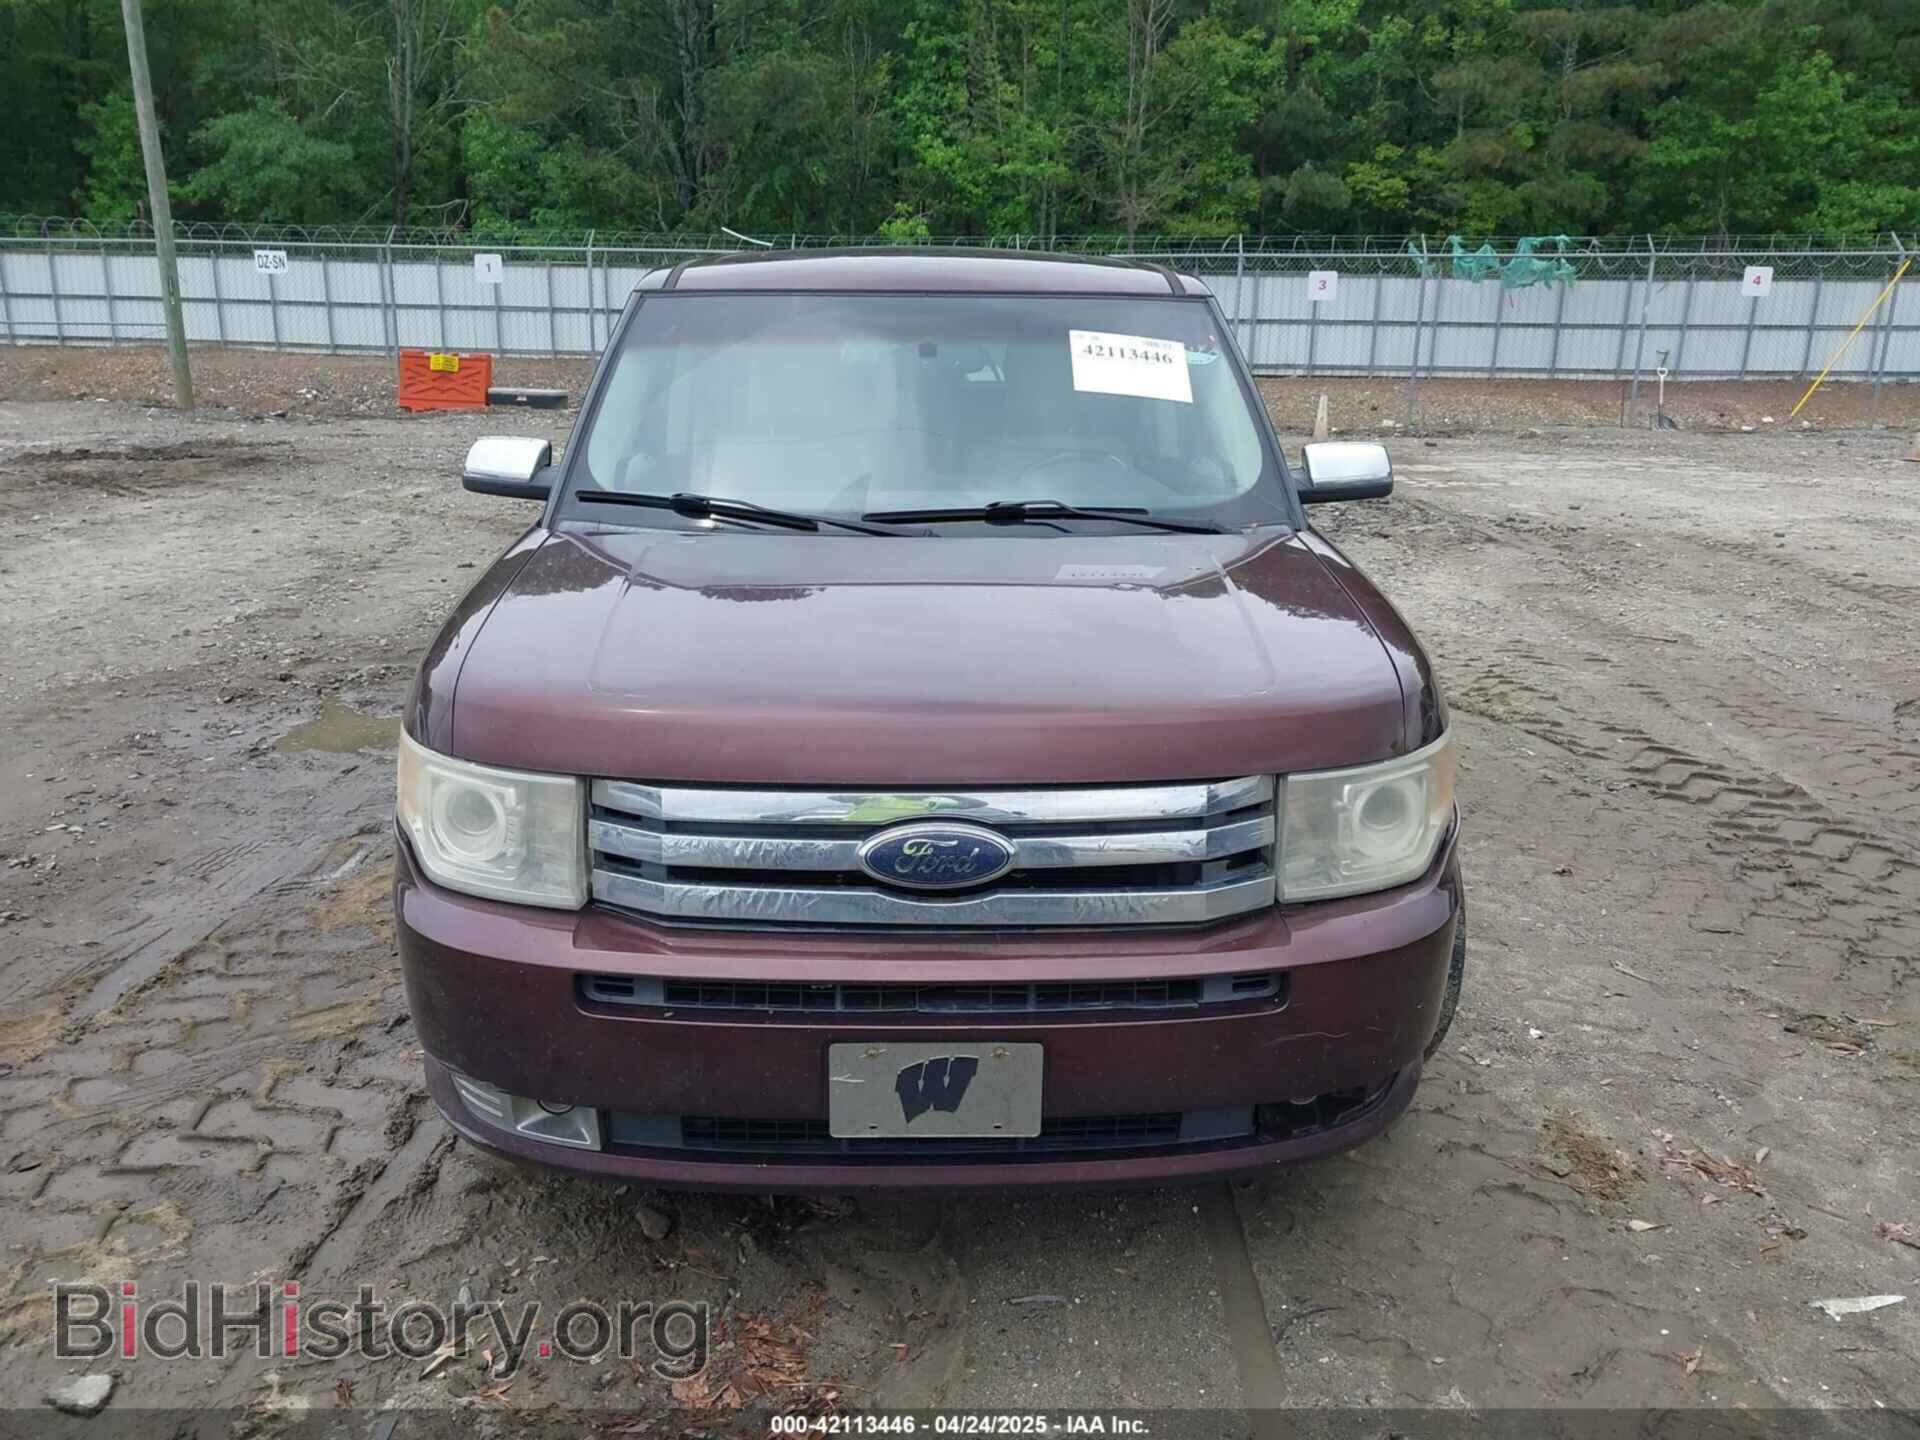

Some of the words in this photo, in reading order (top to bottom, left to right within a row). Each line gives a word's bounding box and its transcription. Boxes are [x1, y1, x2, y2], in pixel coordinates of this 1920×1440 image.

[257, 254, 286, 269] DZ-SN
[1318, 279, 1328, 290] 3
[1752, 275, 1761, 285] 4
[1082, 343, 1174, 365] 42113446
[895, 838, 980, 873] Ford
